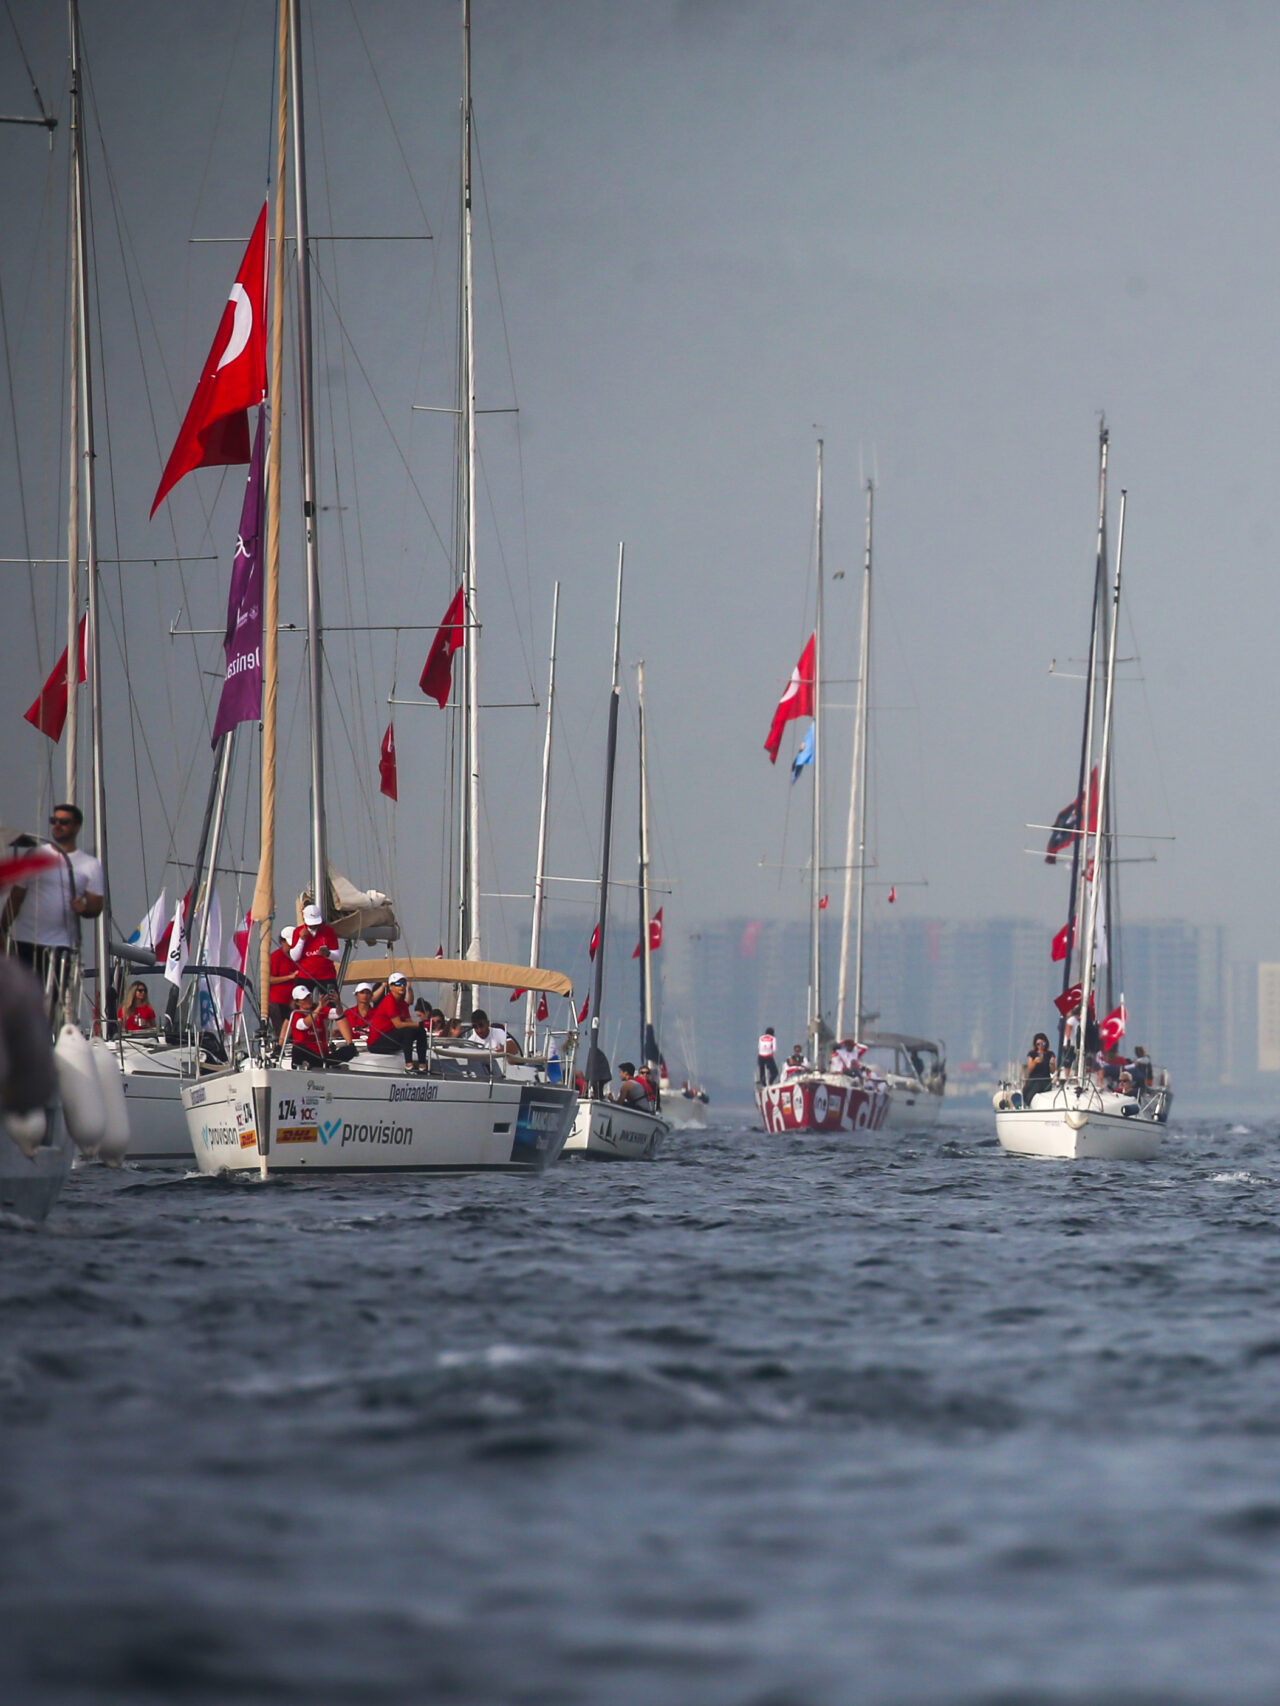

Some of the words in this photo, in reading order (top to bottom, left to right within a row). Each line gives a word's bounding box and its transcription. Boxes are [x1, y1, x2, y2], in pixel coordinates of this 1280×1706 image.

[278, 1100, 297, 1120] 174
[281, 1129, 313, 1141] DHL
[341, 1120, 413, 1147] provision
